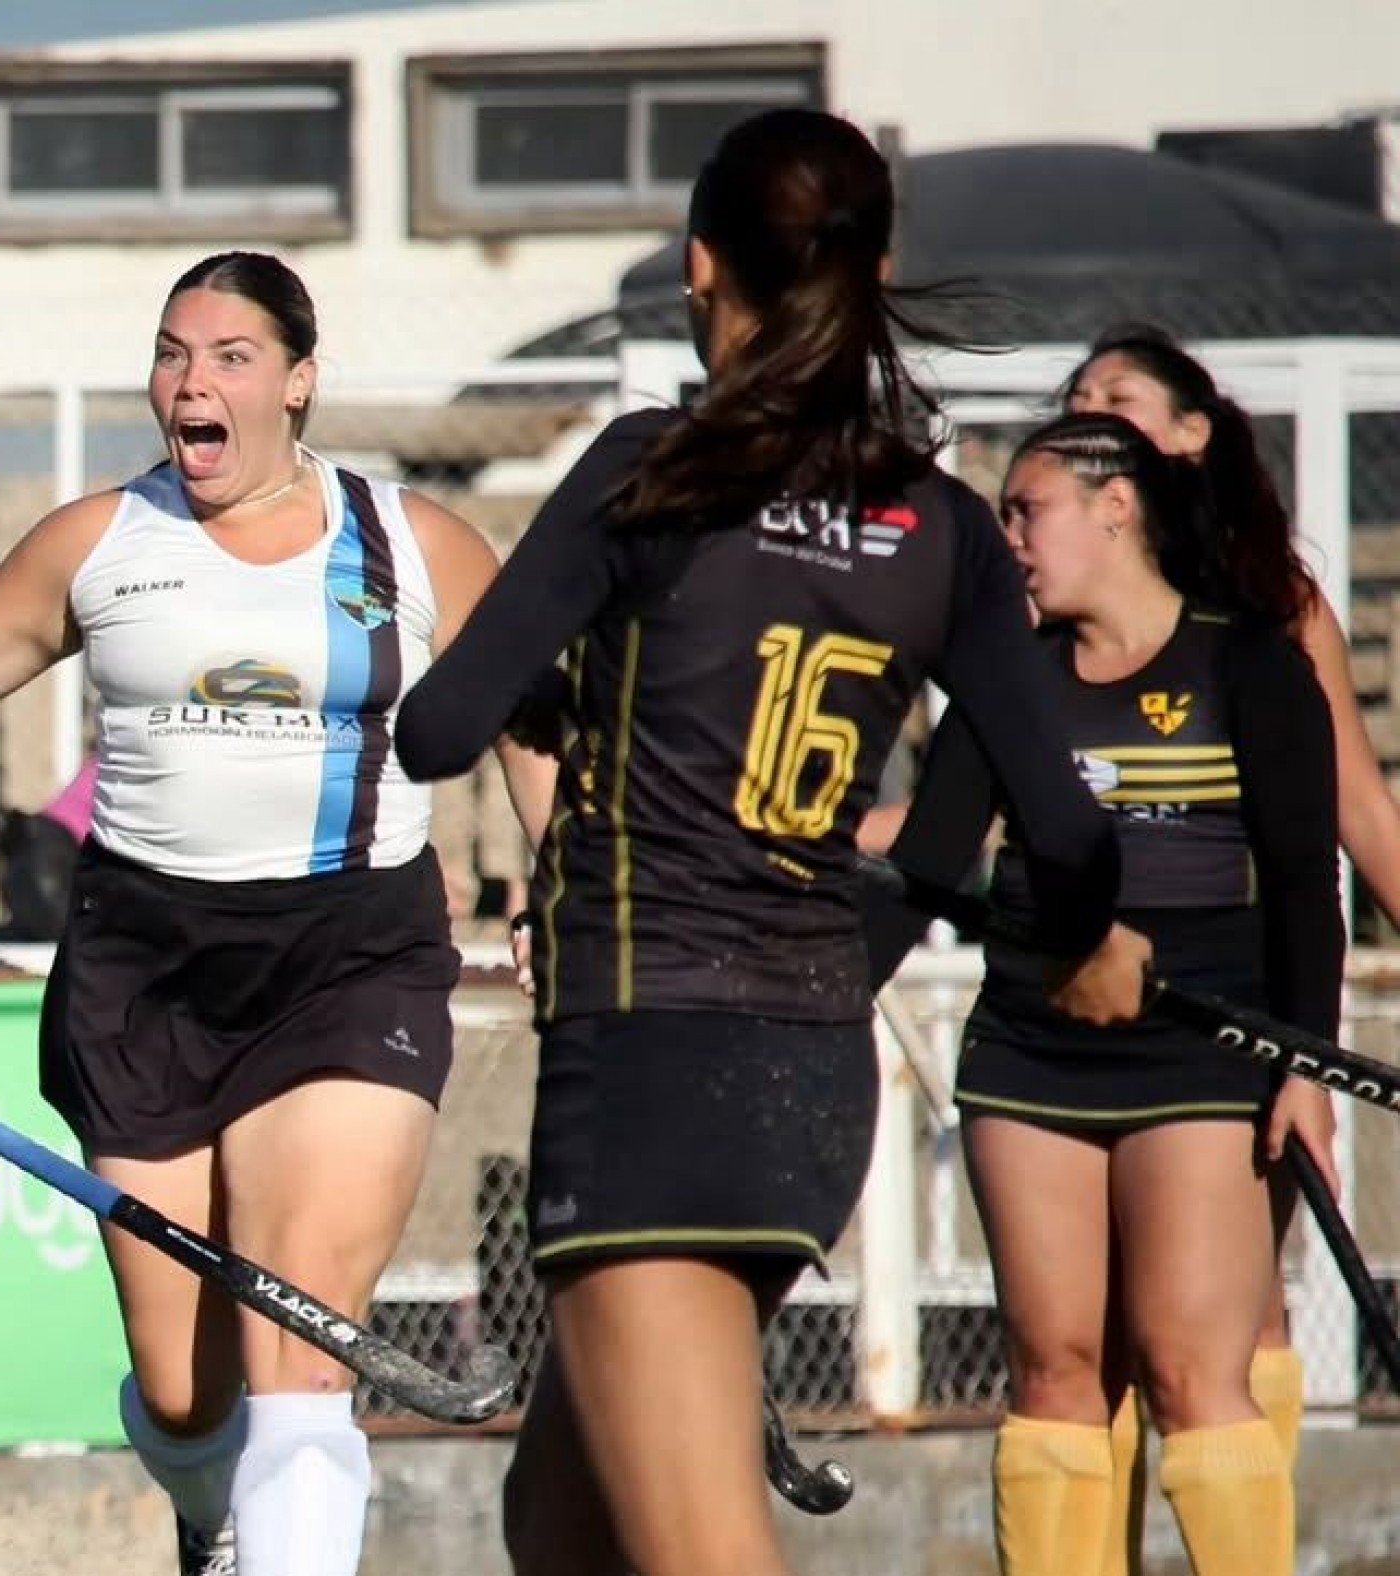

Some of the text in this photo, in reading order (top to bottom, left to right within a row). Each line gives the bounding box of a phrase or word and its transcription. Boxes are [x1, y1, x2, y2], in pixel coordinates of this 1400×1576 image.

[115, 580, 184, 597] WALKER
[734, 622, 894, 839] 16
[255, 1273, 333, 1329] VLACK
